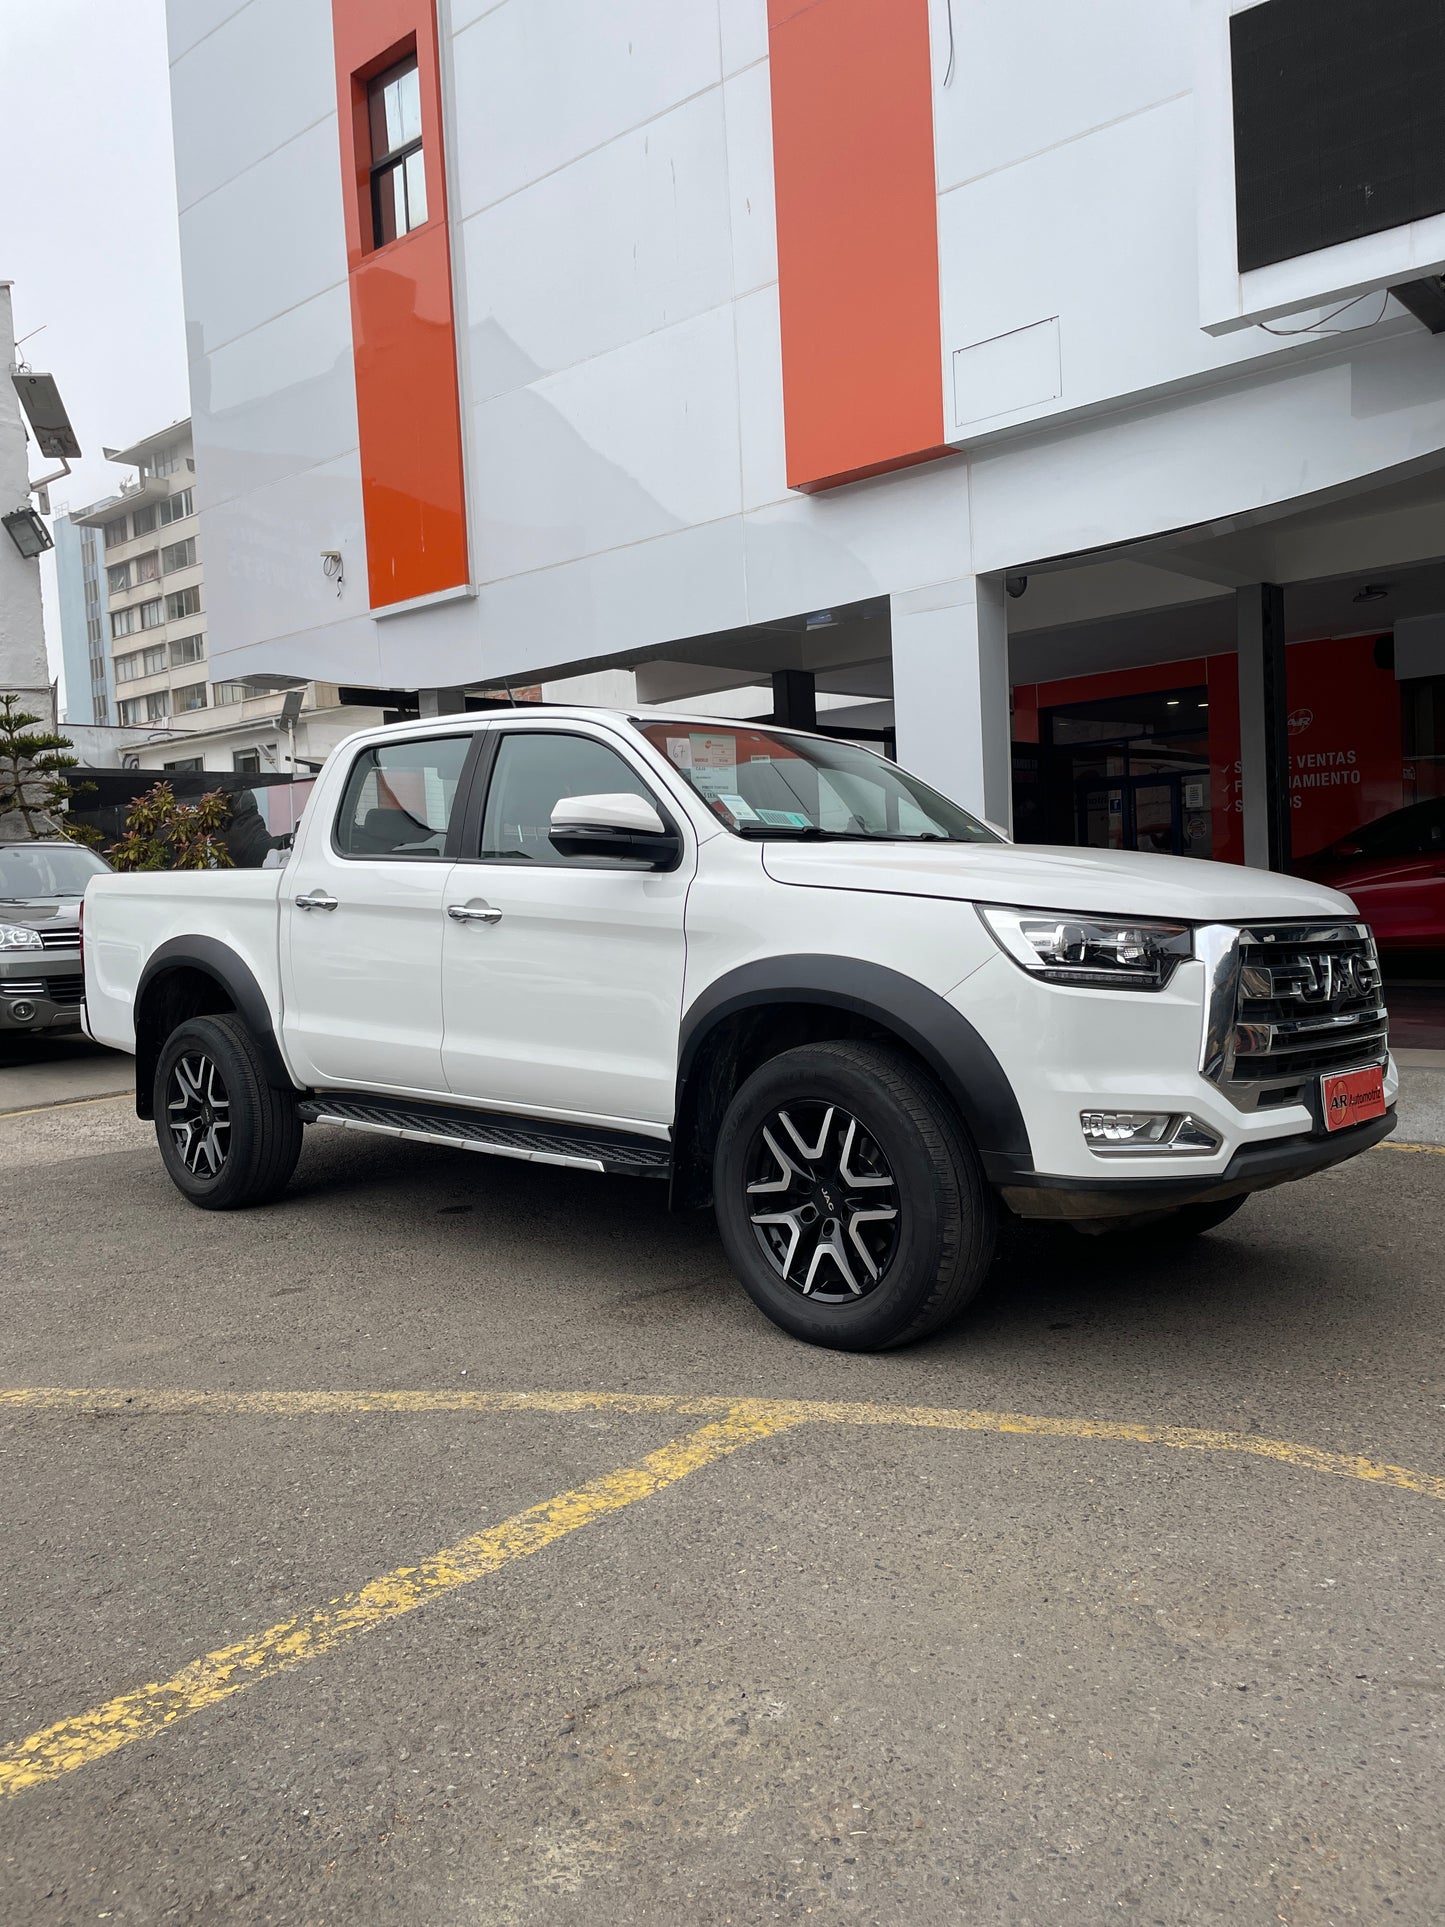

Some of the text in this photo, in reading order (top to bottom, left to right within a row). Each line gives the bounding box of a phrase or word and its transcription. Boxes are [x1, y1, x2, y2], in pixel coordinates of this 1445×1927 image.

[672, 744, 686, 758] 67
[1297, 750, 1357, 769] VENTAS
[1291, 953, 1373, 1003] JAC
[1329, 1094, 1348, 1111] AR
[1348, 1086, 1381, 1107] Automotriz
[820, 1187, 834, 1211] JAC
